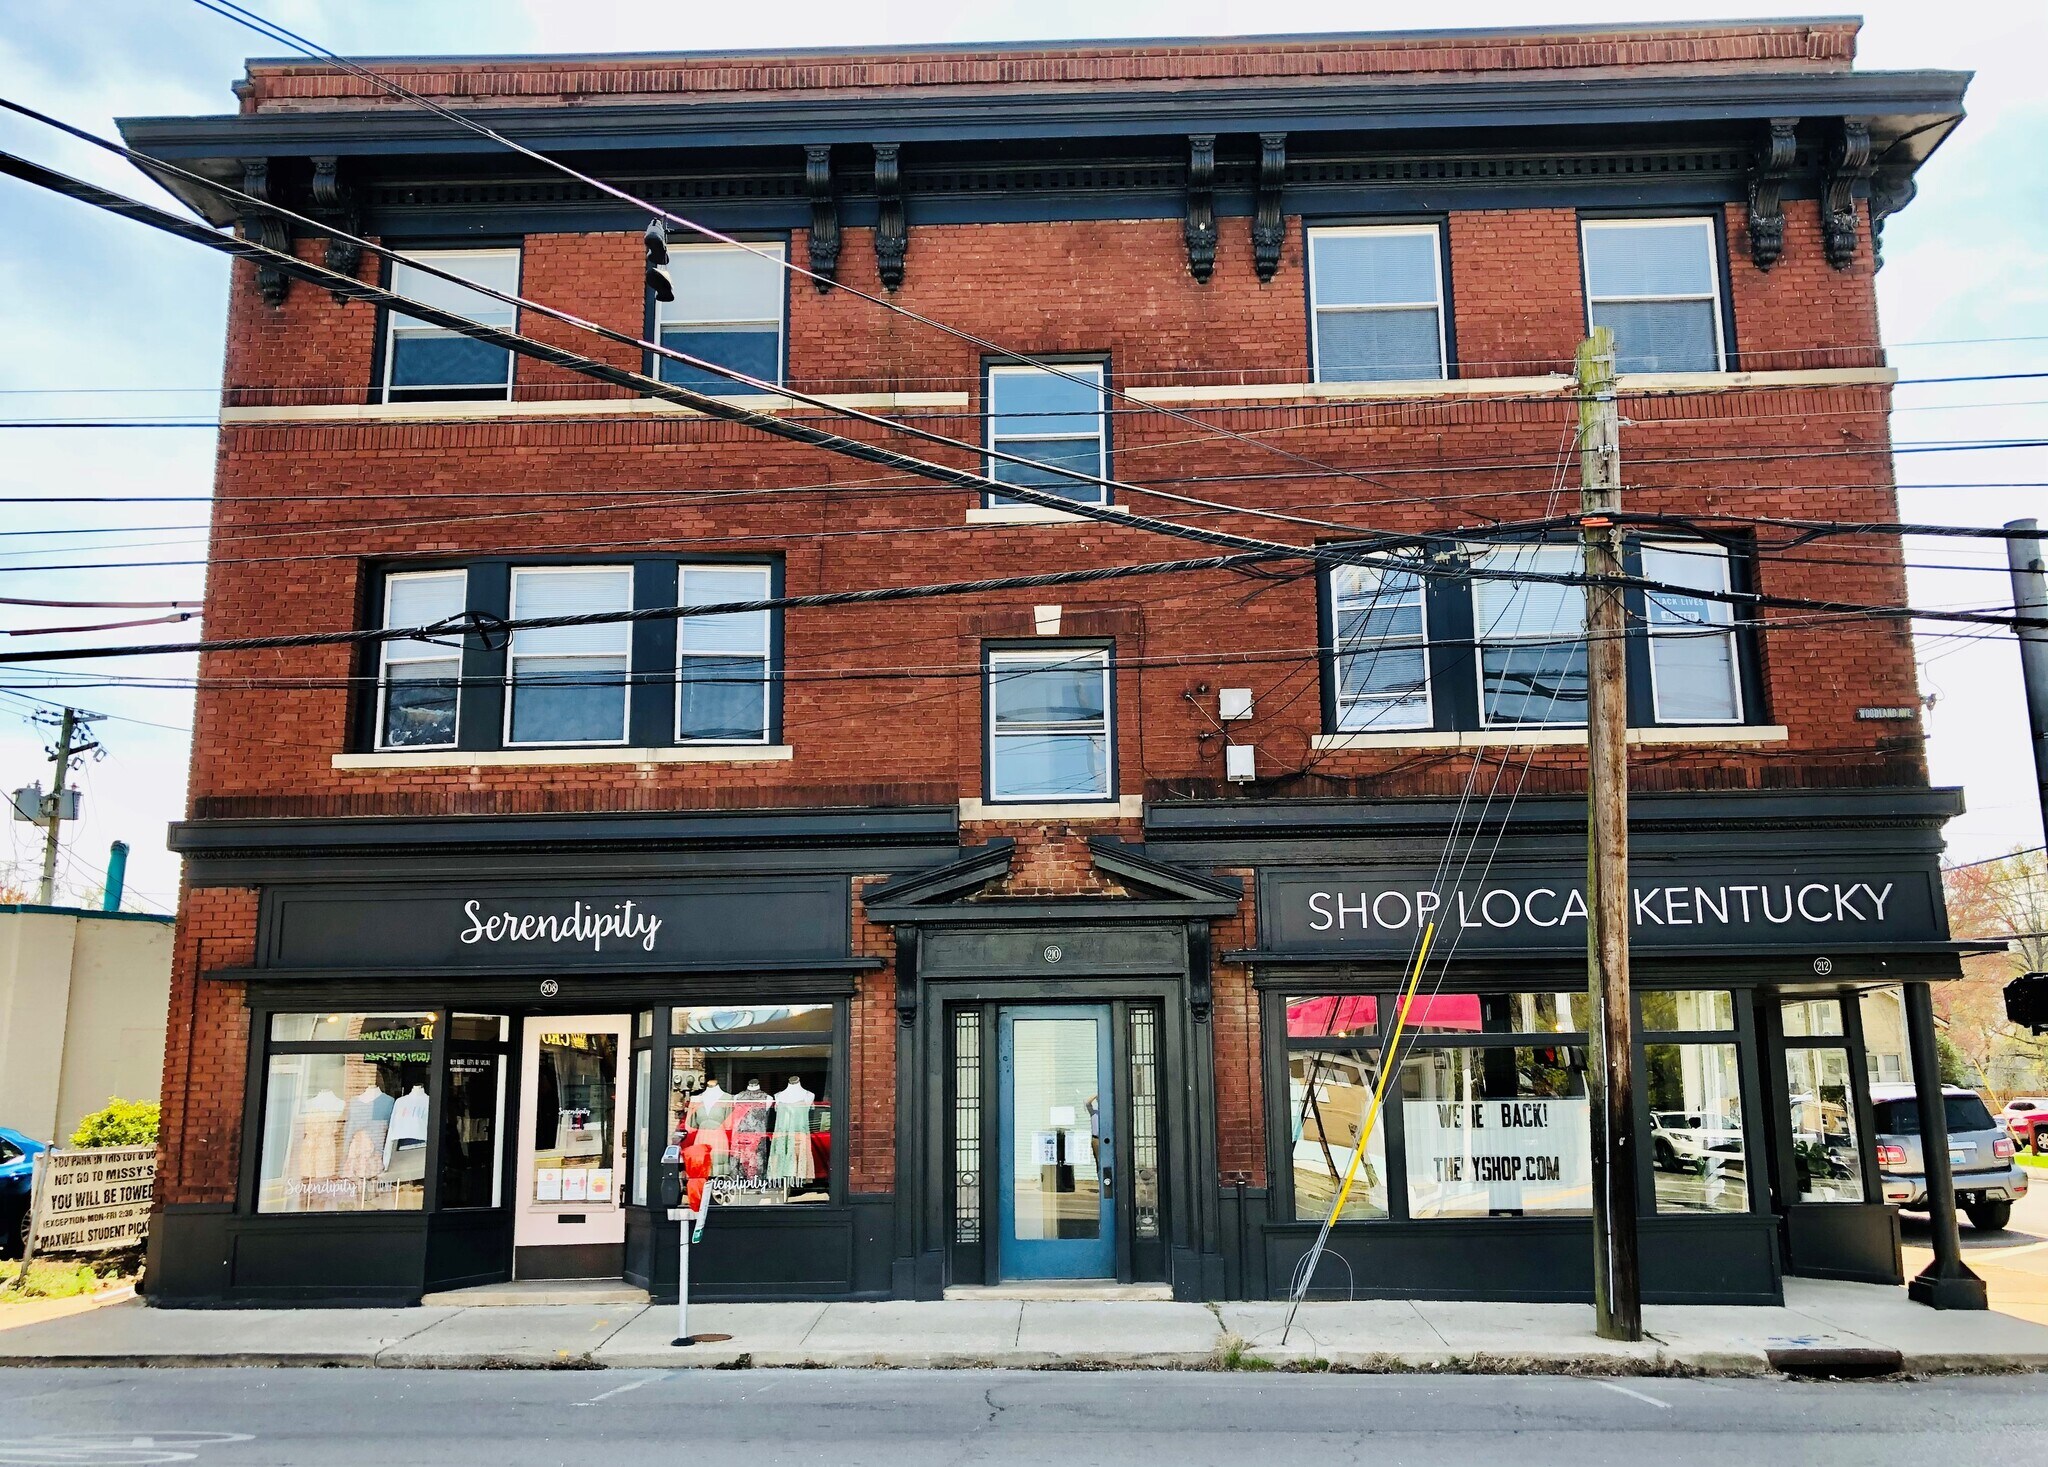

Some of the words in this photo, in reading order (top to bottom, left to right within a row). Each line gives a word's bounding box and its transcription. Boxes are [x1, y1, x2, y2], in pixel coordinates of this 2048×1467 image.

[1681, 598, 1704, 606] LIVES
[1859, 708, 1897, 718] WOODLAND
[1308, 890, 1441, 931] SHOP
[1457, 888, 1589, 929] LOCA
[1633, 883, 1893, 926] KENTUCKY
[460, 899, 663, 952] Serendipity
[1047, 949, 1060, 960] 210
[1816, 961, 1829, 971] 212
[542, 983, 557, 993] 208
[1500, 1103, 1548, 1128] BACK!
[54, 1173, 74, 1186] NOT
[76, 1172, 89, 1183] GO
[93, 1170, 103, 1181] TO
[105, 1165, 154, 1180] MISSY'S
[1434, 1156, 1560, 1182] THEYSHOP.COM
[284, 1178, 358, 1197] Serendipity
[711, 1175, 769, 1193] rendipity
[51, 1193, 72, 1210] YOU
[75, 1190, 100, 1207] WILL
[103, 1188, 117, 1204] BE
[120, 1184, 154, 1202] TOWED
[40, 1230, 85, 1249] MAXWELL
[87, 1224, 126, 1242] STUDENT
